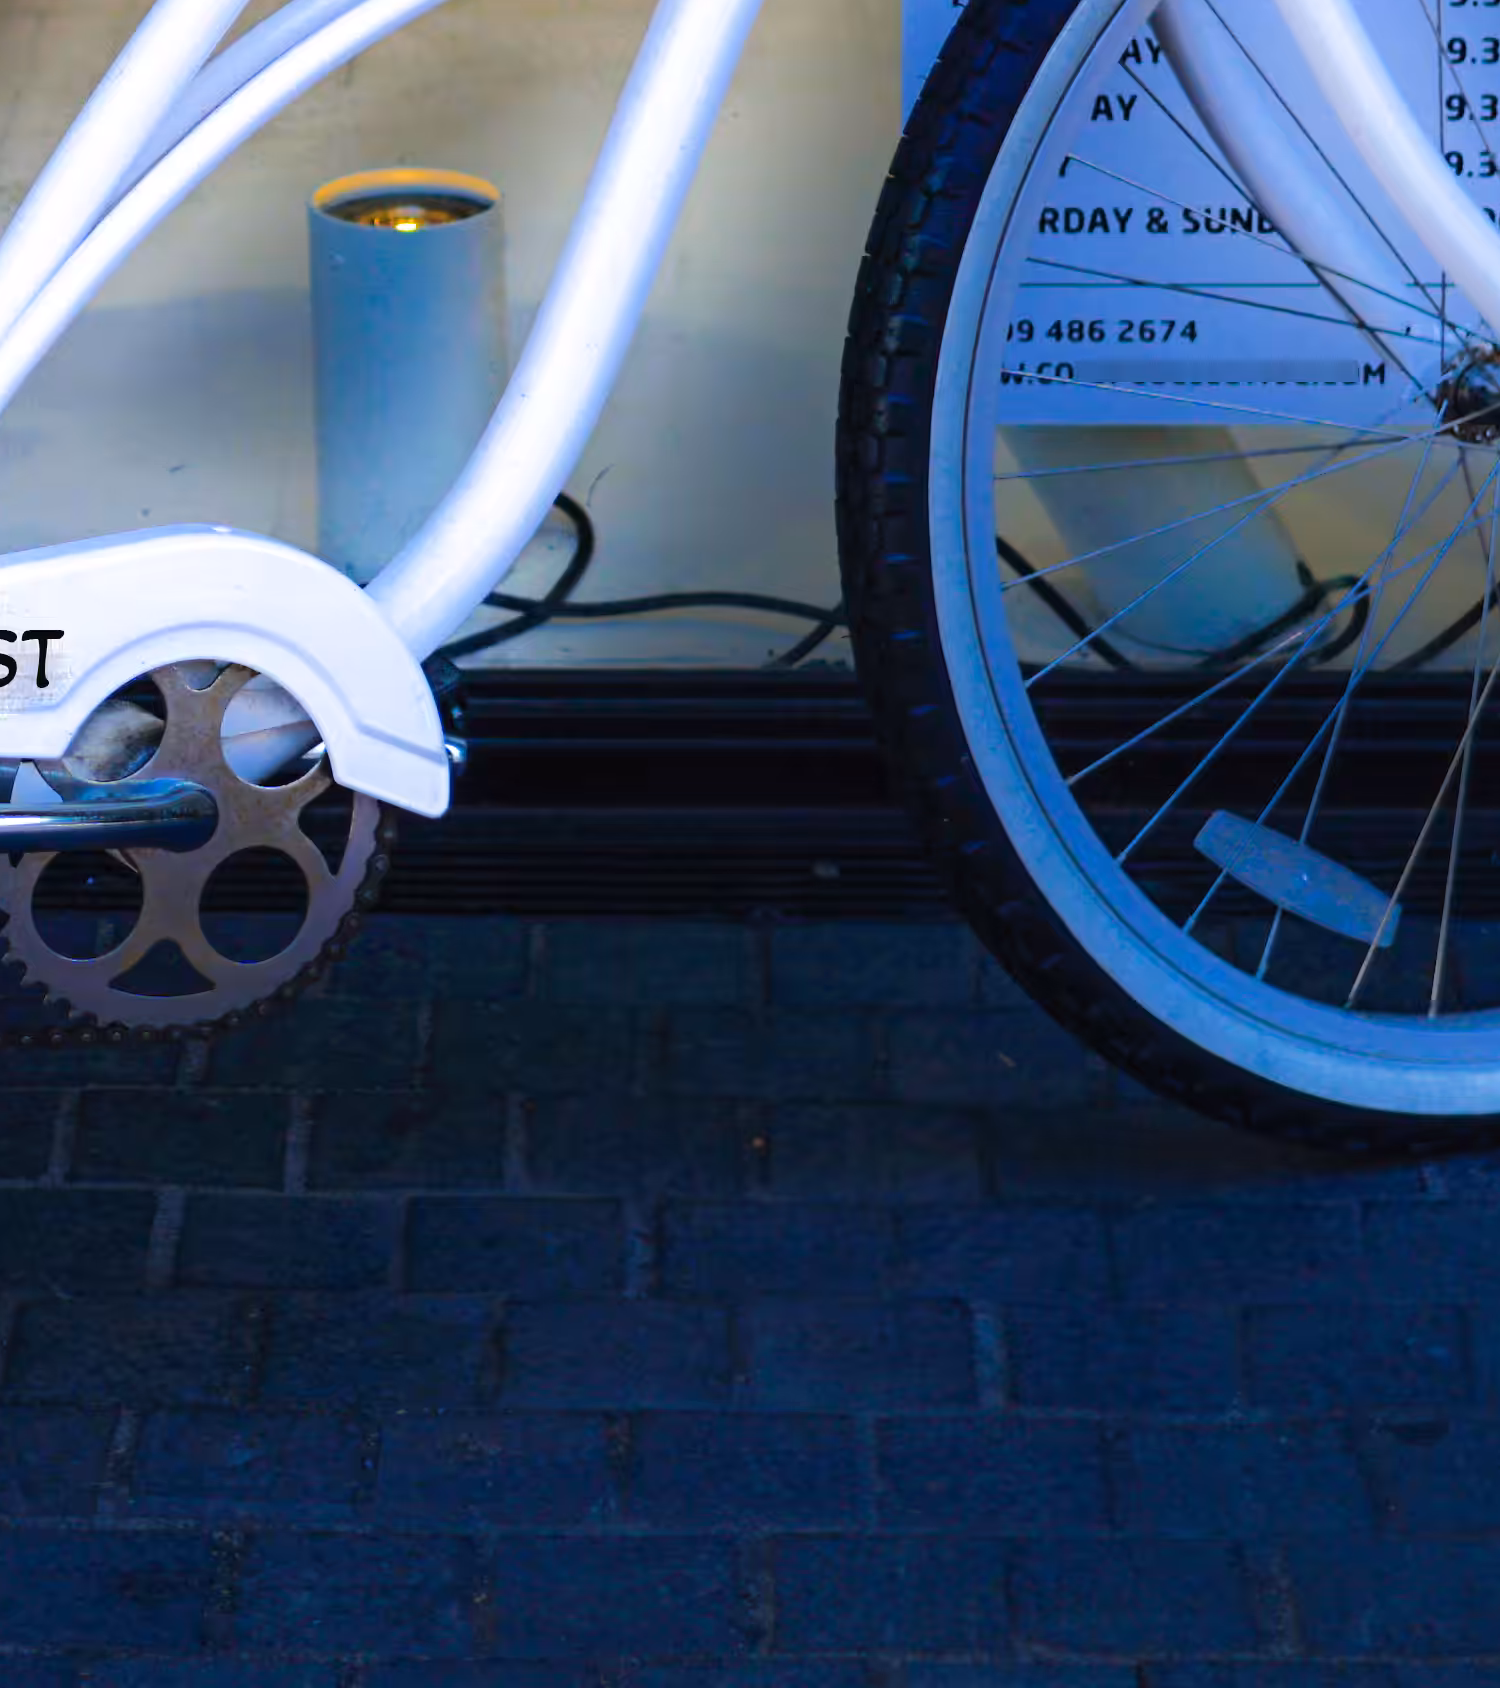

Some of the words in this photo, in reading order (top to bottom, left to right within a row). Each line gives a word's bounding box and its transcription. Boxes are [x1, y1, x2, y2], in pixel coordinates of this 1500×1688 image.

[1038, 206, 1133, 235] RDAY
[1145, 207, 1169, 234] &
[1182, 206, 1276, 235] SUND
[1047, 319, 1106, 343] 486
[1117, 319, 1198, 343] 2674
